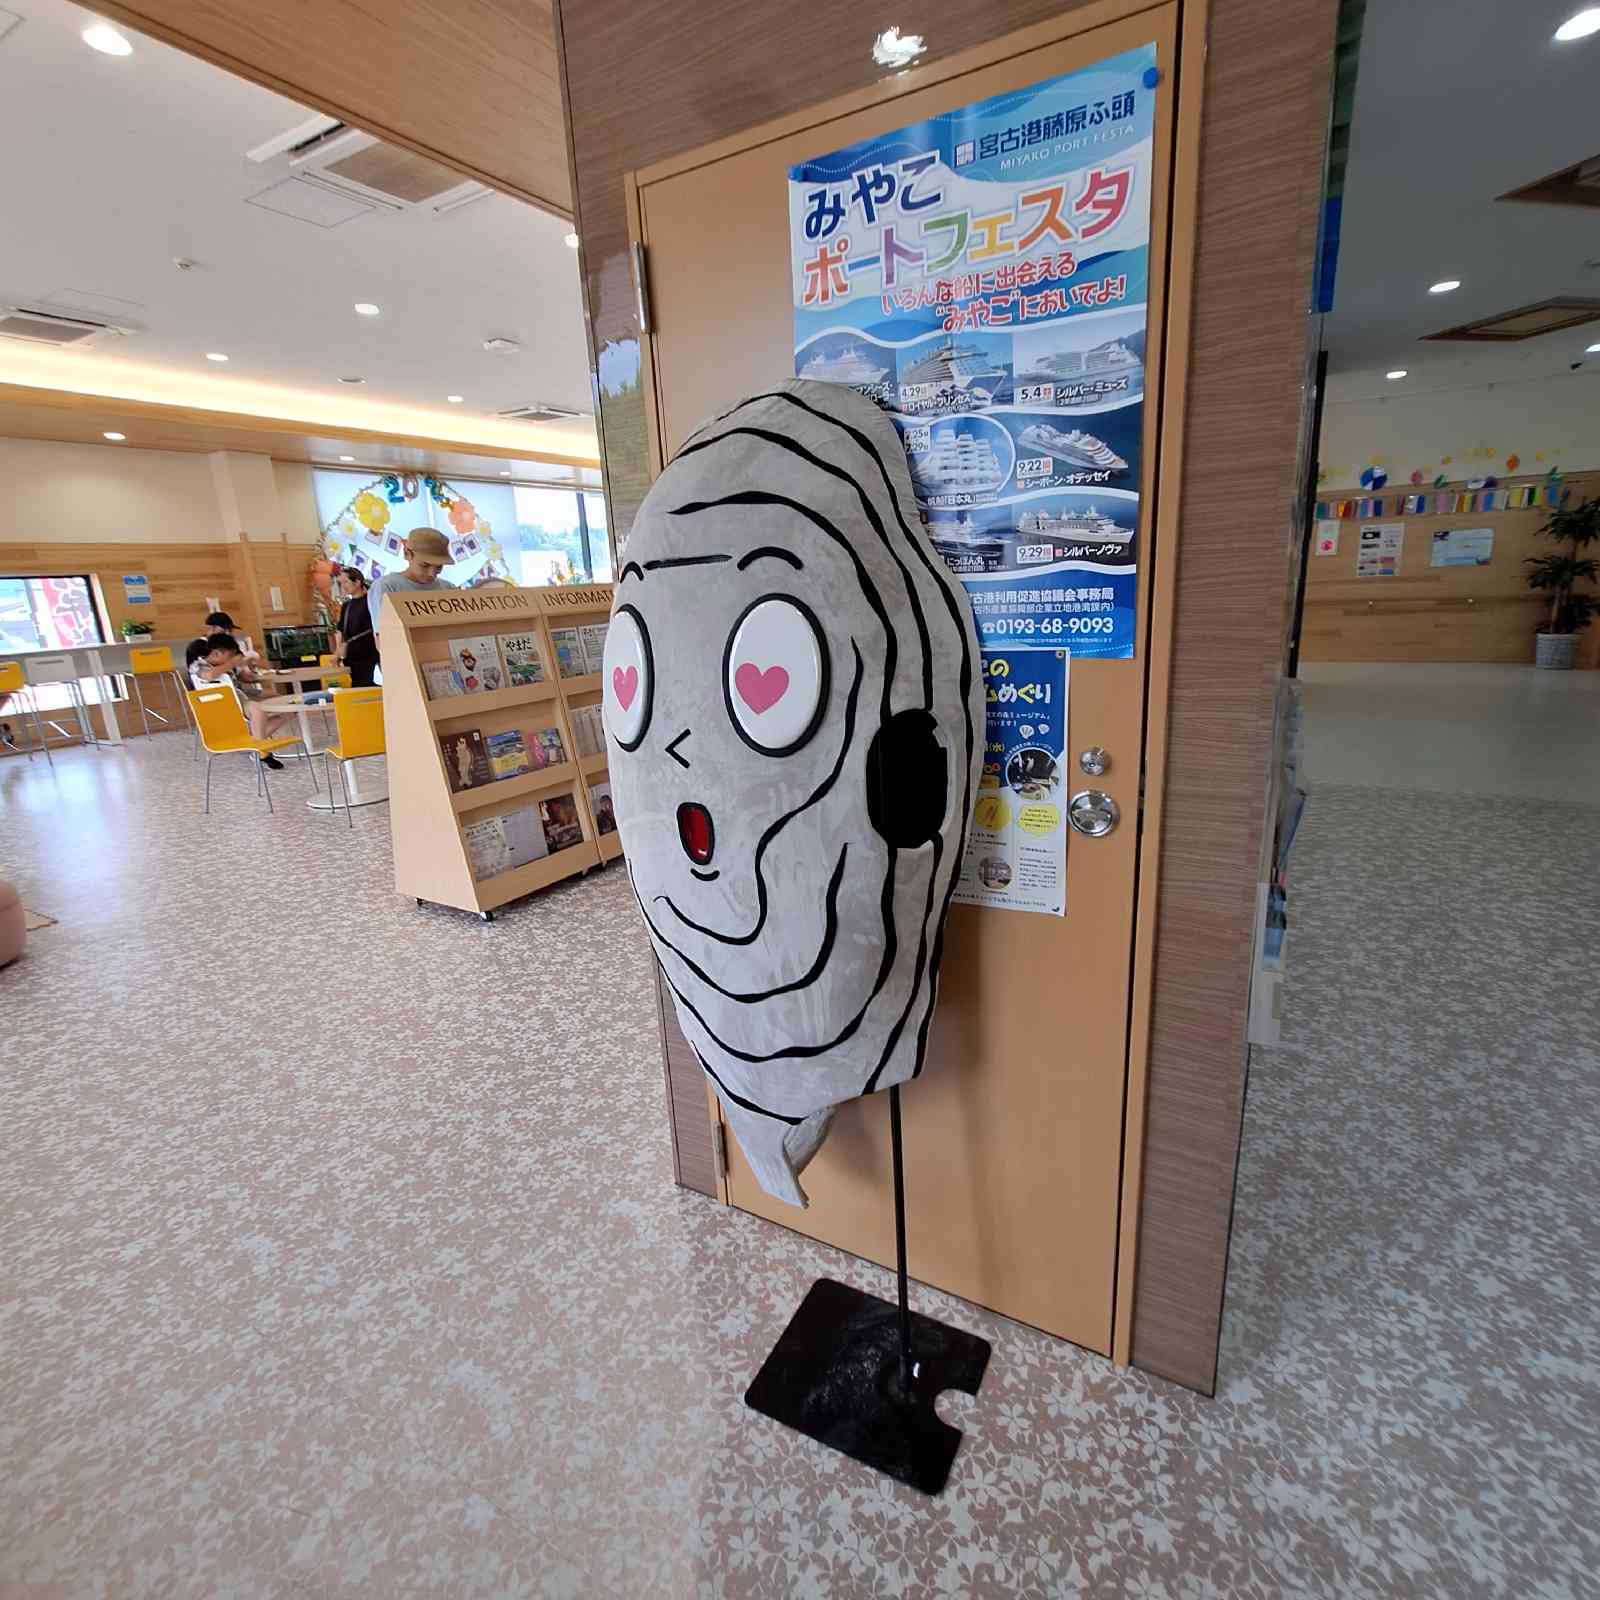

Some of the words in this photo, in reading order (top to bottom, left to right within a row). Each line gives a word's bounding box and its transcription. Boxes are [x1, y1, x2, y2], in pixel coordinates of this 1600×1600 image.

[979, 90, 1136, 160] 宮古港藤原ふ頭
[1000, 149, 1050, 170] MIYAKO
[1055, 139, 1088, 155] PORT
[1093, 125, 1135, 143] FESTA
[804, 154, 941, 239] みやこ
[803, 170, 1130, 304] ポートフェスタ
[882, 252, 1076, 313] いろんな船に出会える
[1021, 387, 1041, 400] 5.4
[1018, 460, 1042, 473] 9.22
[405, 594, 528, 616] INFORMATION
[970, 587, 1114, 605] 古港利用促進協議会事務局
[996, 617, 1114, 634] 0193-68-9093
